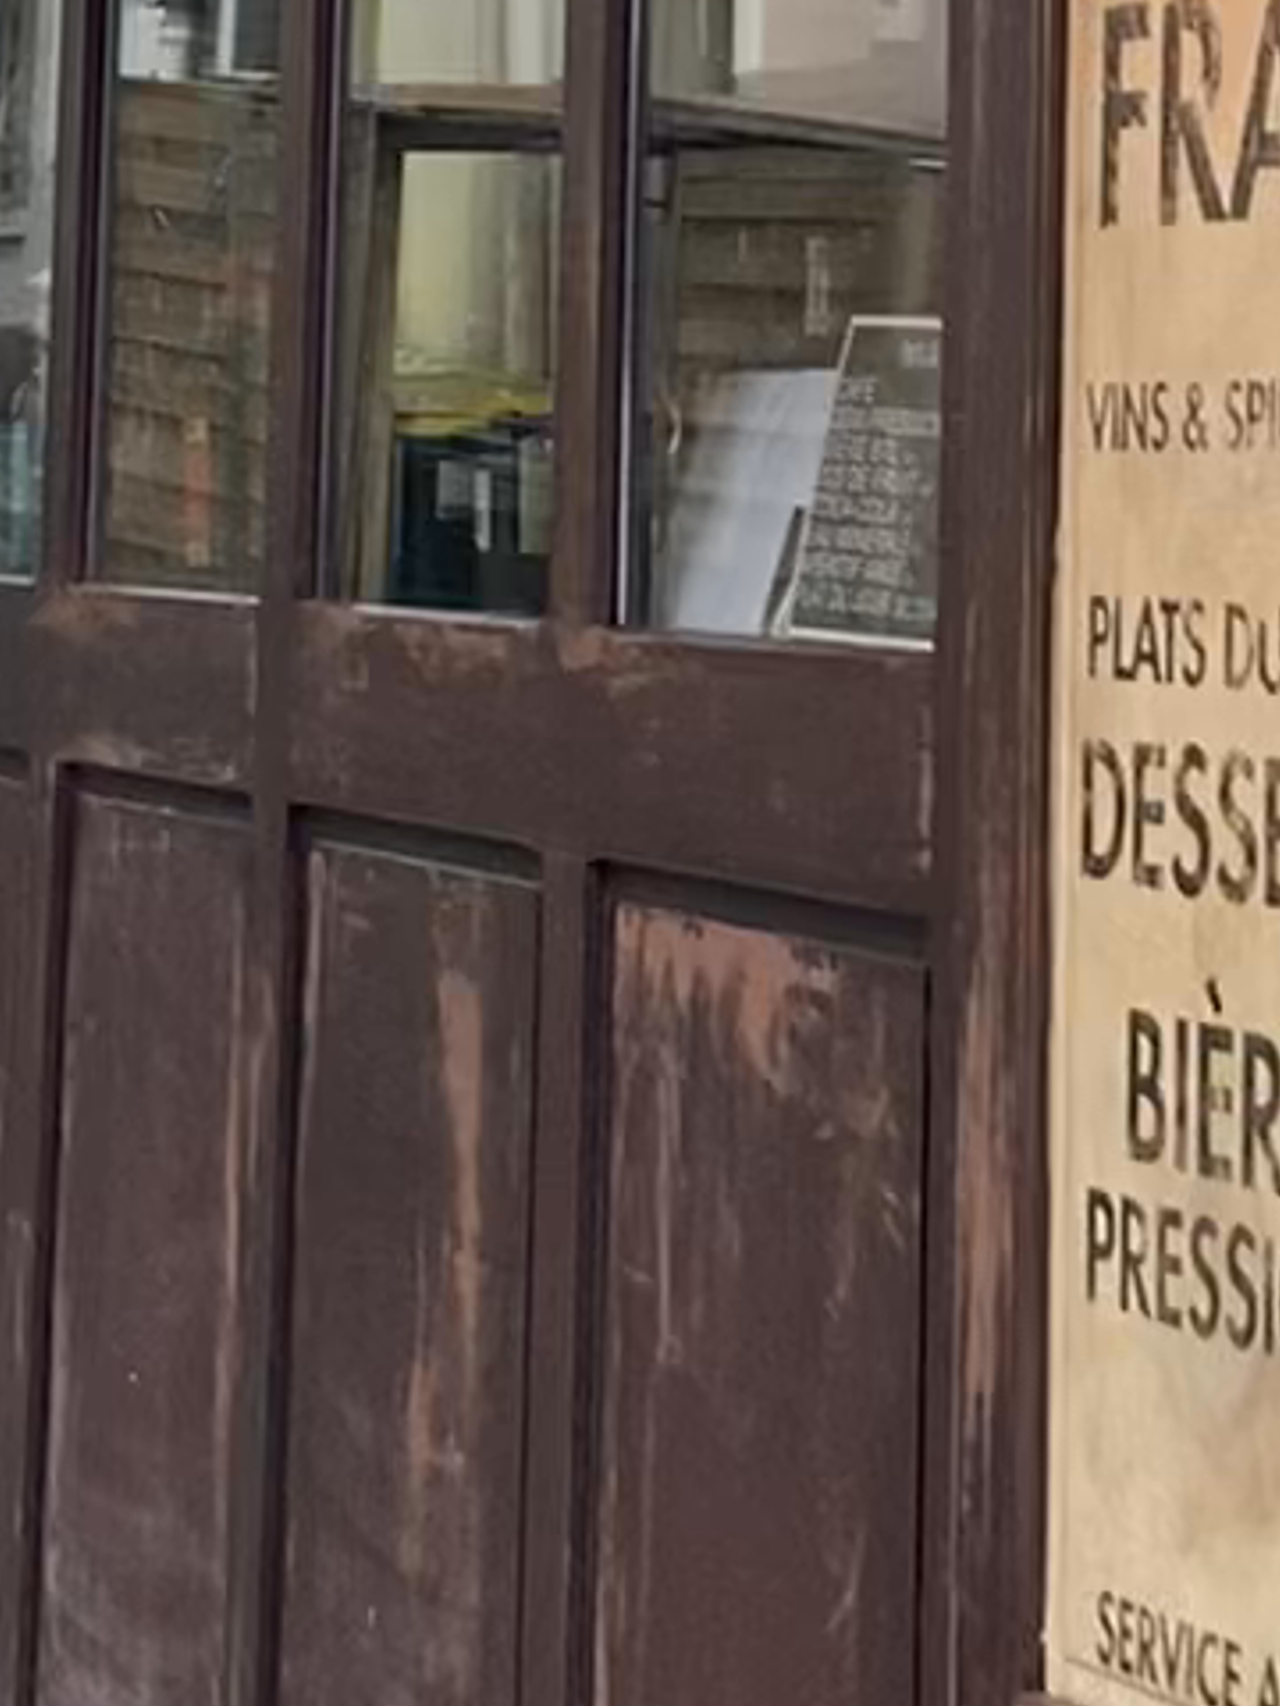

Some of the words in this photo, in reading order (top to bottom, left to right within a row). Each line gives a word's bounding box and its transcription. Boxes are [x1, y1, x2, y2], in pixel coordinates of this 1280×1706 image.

[1086, 383, 1170, 453] VINS
[1181, 384, 1209, 450] &
[1087, 595, 1208, 687] PLATS
